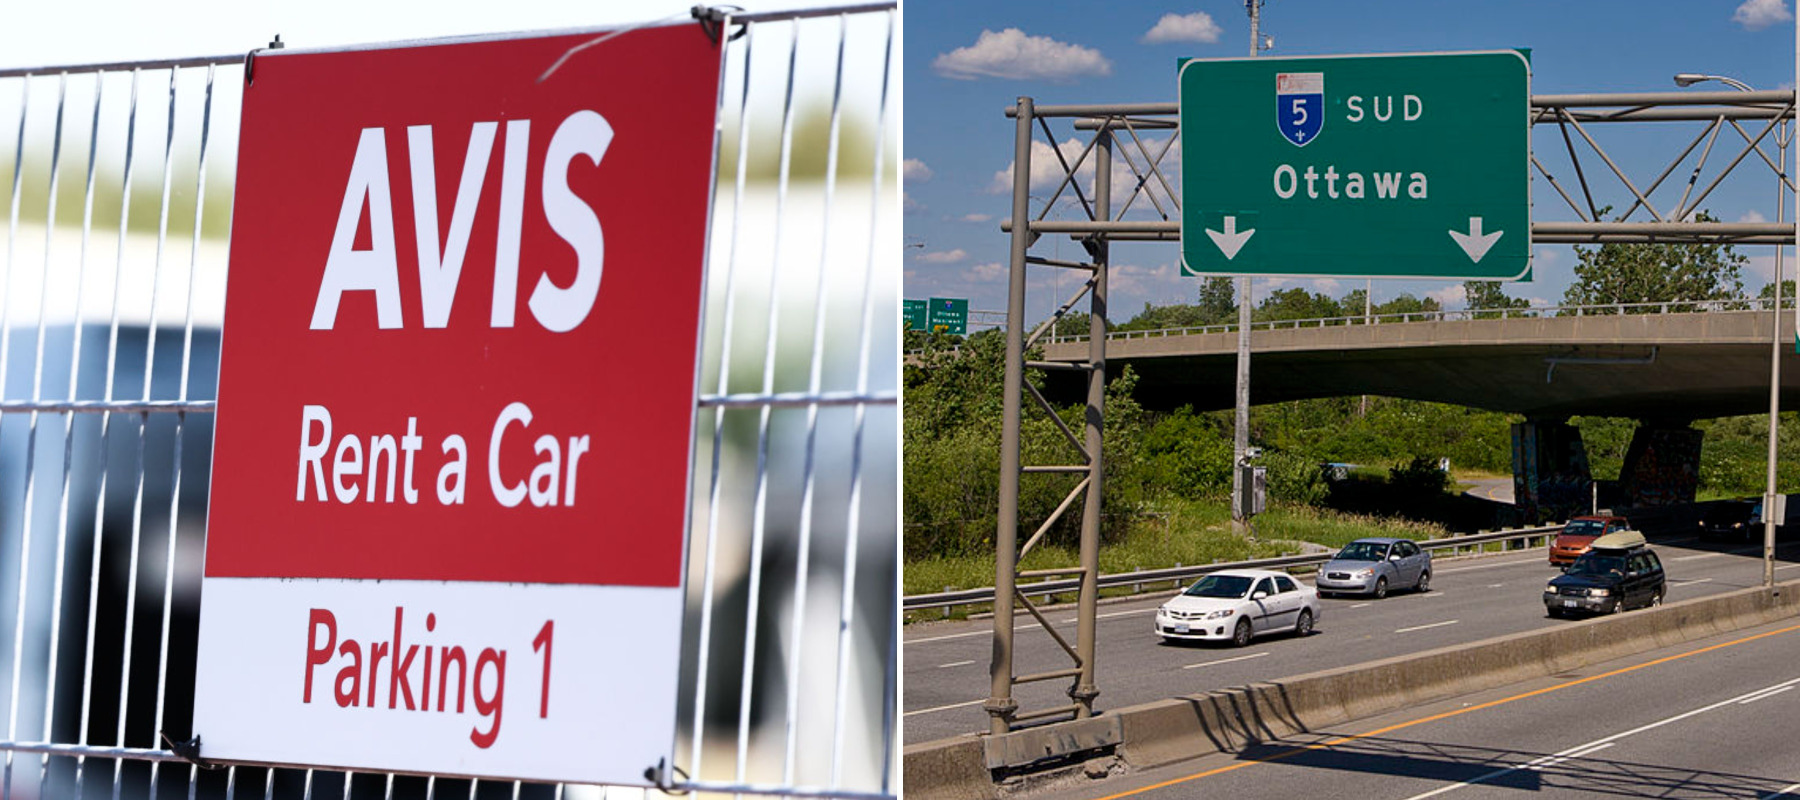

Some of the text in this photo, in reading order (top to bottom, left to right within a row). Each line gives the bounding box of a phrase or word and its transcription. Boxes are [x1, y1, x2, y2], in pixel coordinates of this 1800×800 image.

[1292, 94, 1423, 126] 5 SUD
[309, 110, 615, 333] AVIS
[1273, 164, 1428, 199] Ottawa
[296, 402, 590, 508] Rent a Car
[303, 606, 554, 749] Parking 1
